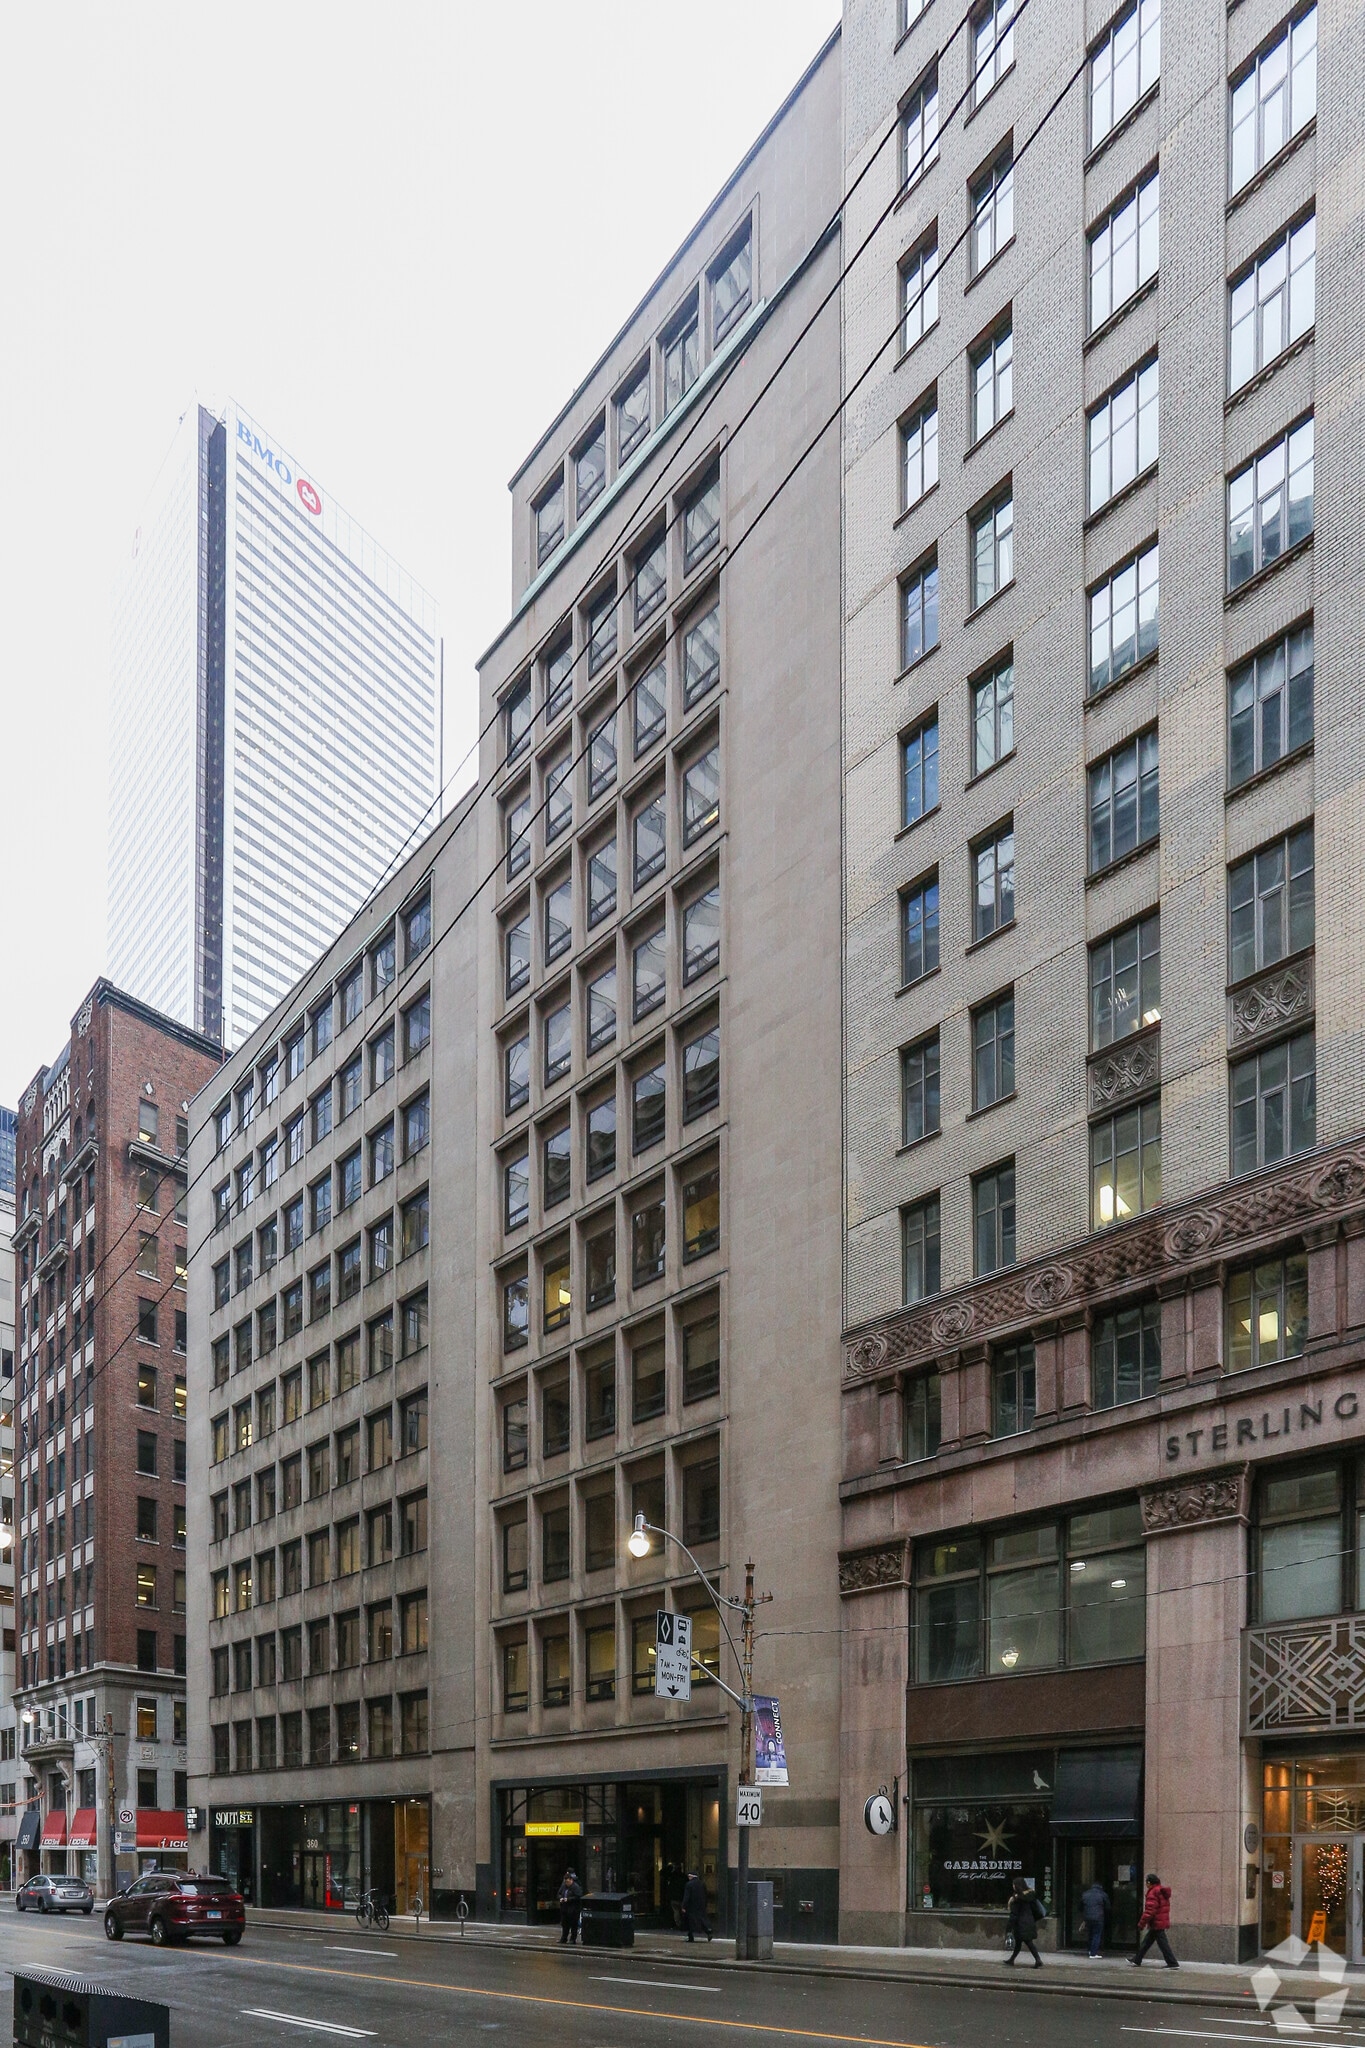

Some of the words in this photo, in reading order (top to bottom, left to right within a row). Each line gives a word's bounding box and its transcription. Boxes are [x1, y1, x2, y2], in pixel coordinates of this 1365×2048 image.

[236, 418, 293, 485] BMO
[1165, 1392, 1359, 1461] STERLING
[661, 1672, 686, 1683] MON-FRI
[739, 1790, 760, 1798] MAXIMUM
[738, 1803, 760, 1821] 40
[306, 1839, 319, 1848] 360
[944, 1861, 1022, 1870] GABARDINE
